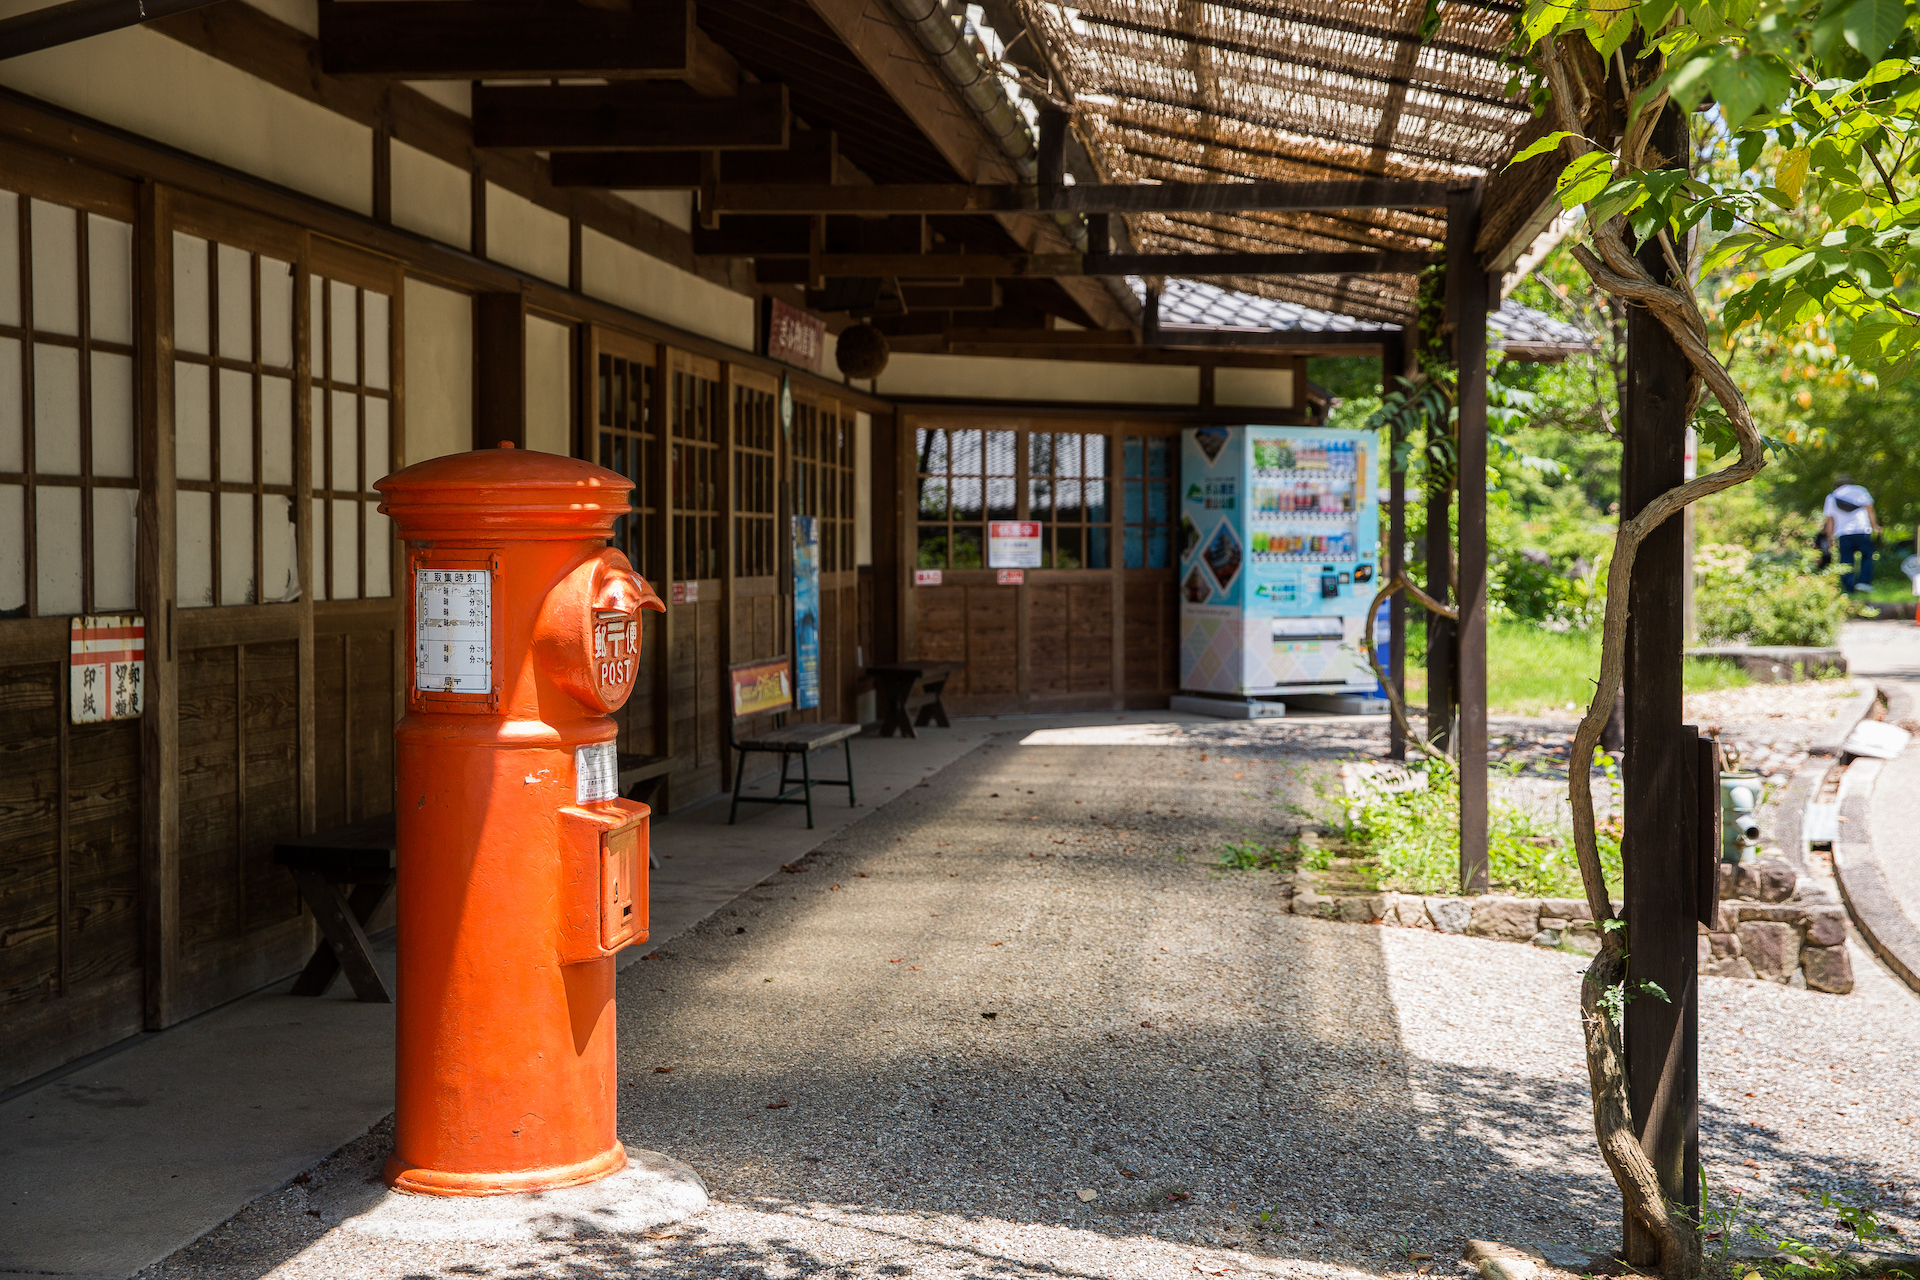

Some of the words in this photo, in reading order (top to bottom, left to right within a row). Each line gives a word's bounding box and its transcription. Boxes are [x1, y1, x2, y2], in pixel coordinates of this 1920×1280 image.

[434, 572, 477, 583] 取集時刻
[83, 666, 97, 715] 印紙
[115, 664, 127, 717] 切手類
[601, 659, 631, 686] POST
